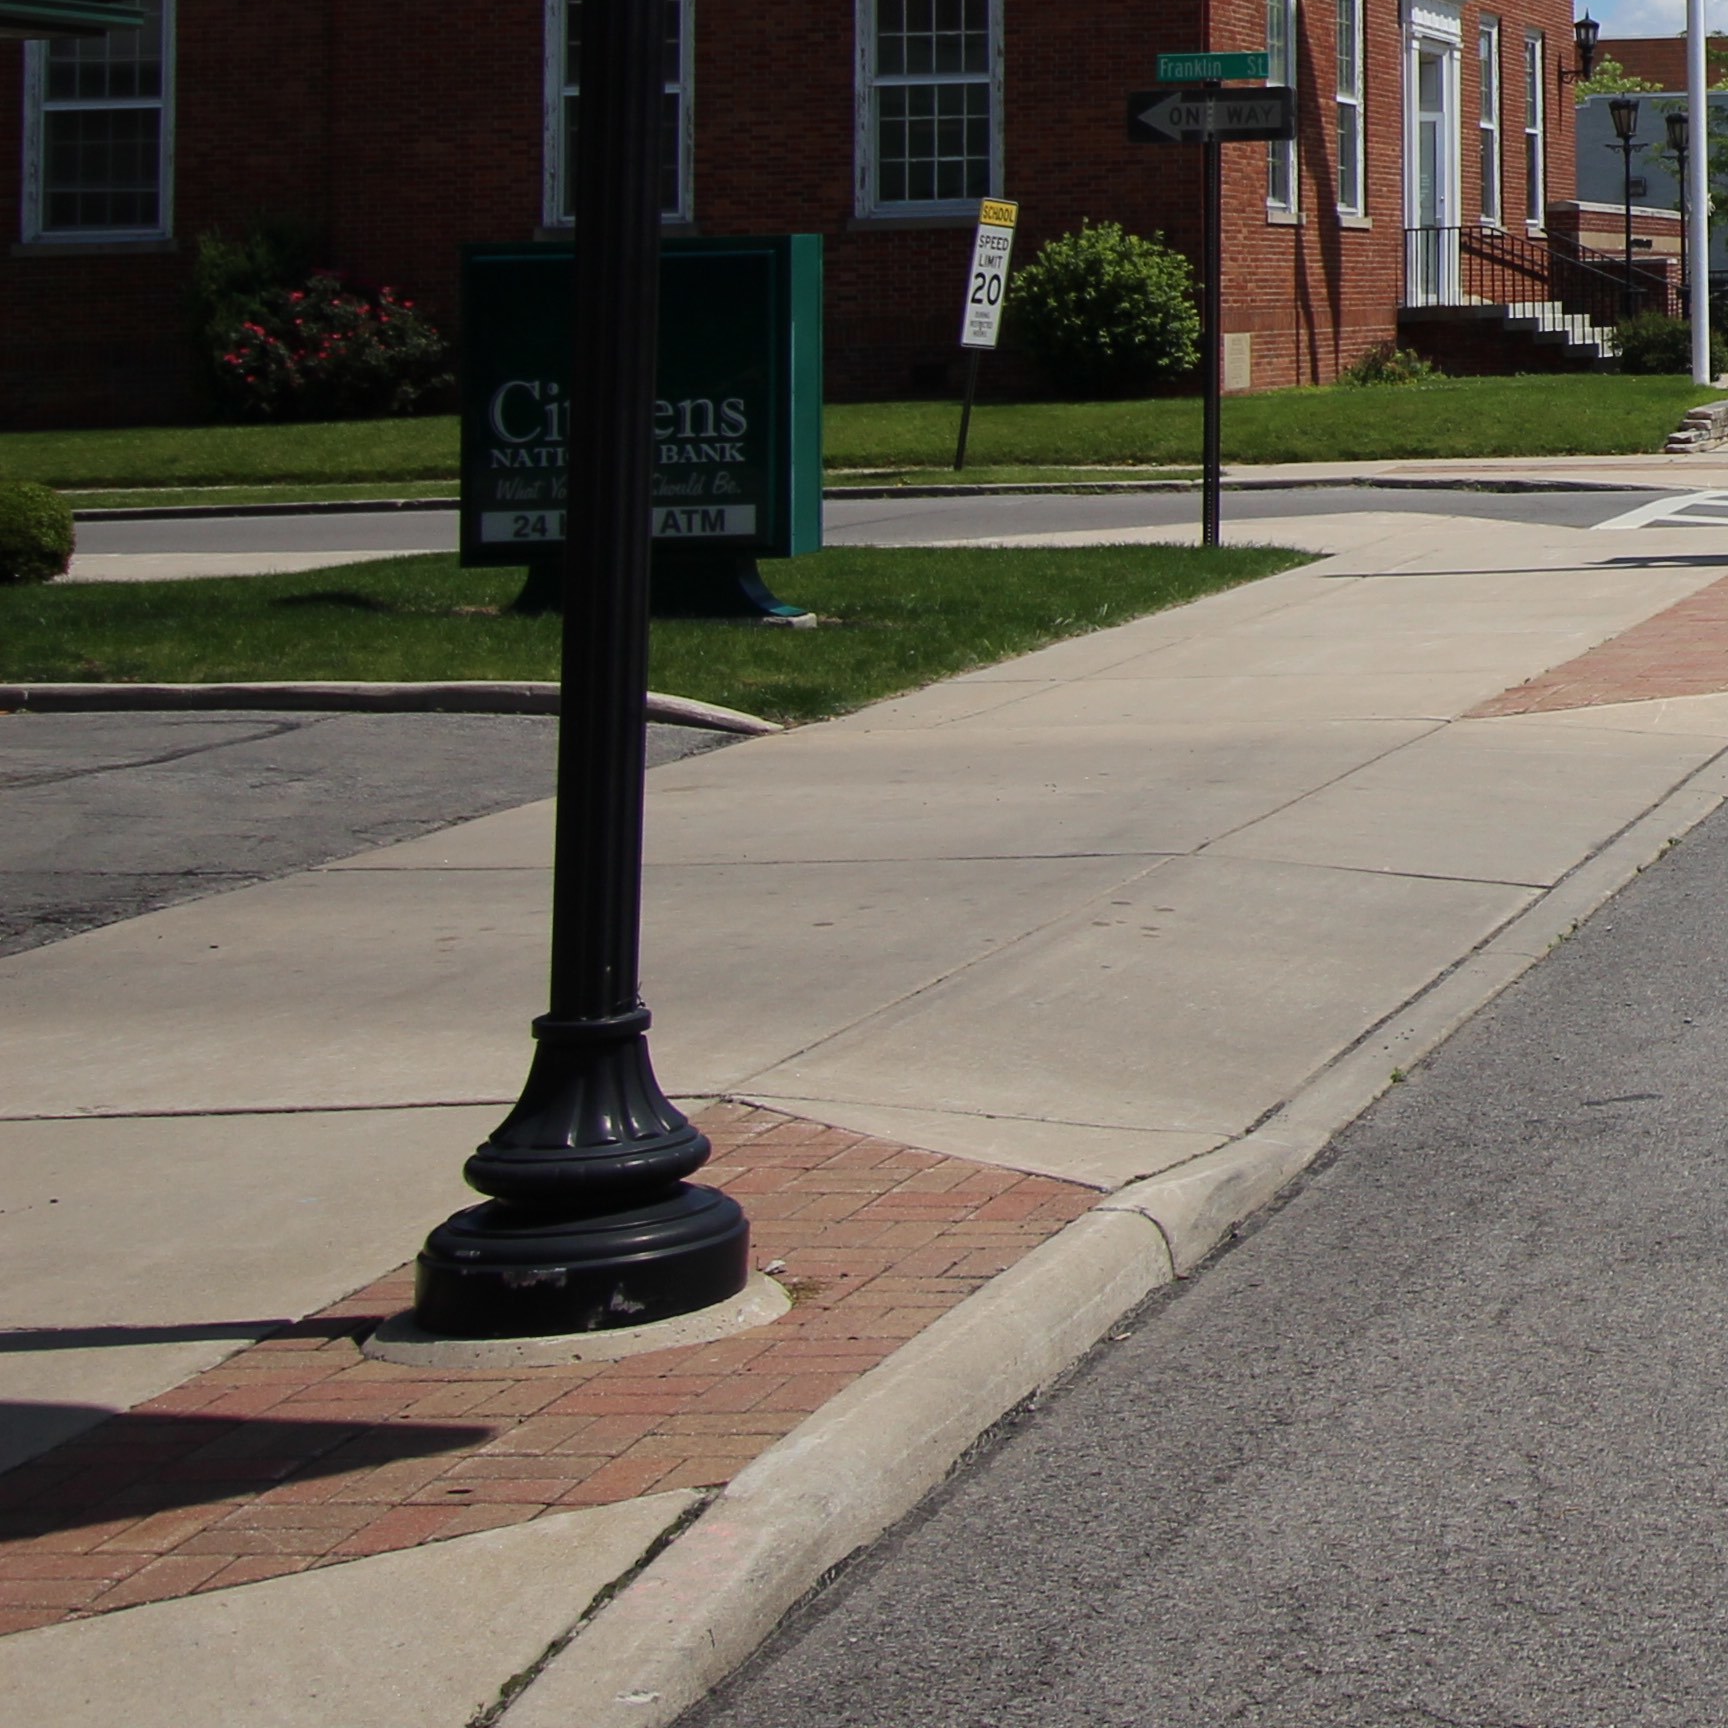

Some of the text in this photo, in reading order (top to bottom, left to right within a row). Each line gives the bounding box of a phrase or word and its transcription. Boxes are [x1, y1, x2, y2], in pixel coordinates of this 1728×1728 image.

[1160, 56, 1264, 78] Franklin St
[1169, 103, 1274, 126] ON WAY
[982, 205, 1014, 223] SCHOOL
[979, 235, 1009, 251] SPEED
[979, 254, 1003, 269] LIMIT
[971, 272, 1001, 306] 20
[489, 380, 747, 443] Ciens
[659, 442, 746, 464] BANK
[496, 477, 546, 500] What
[712, 471, 742, 495] Be.
[513, 515, 548, 538] 24
[660, 509, 725, 534] ATM
